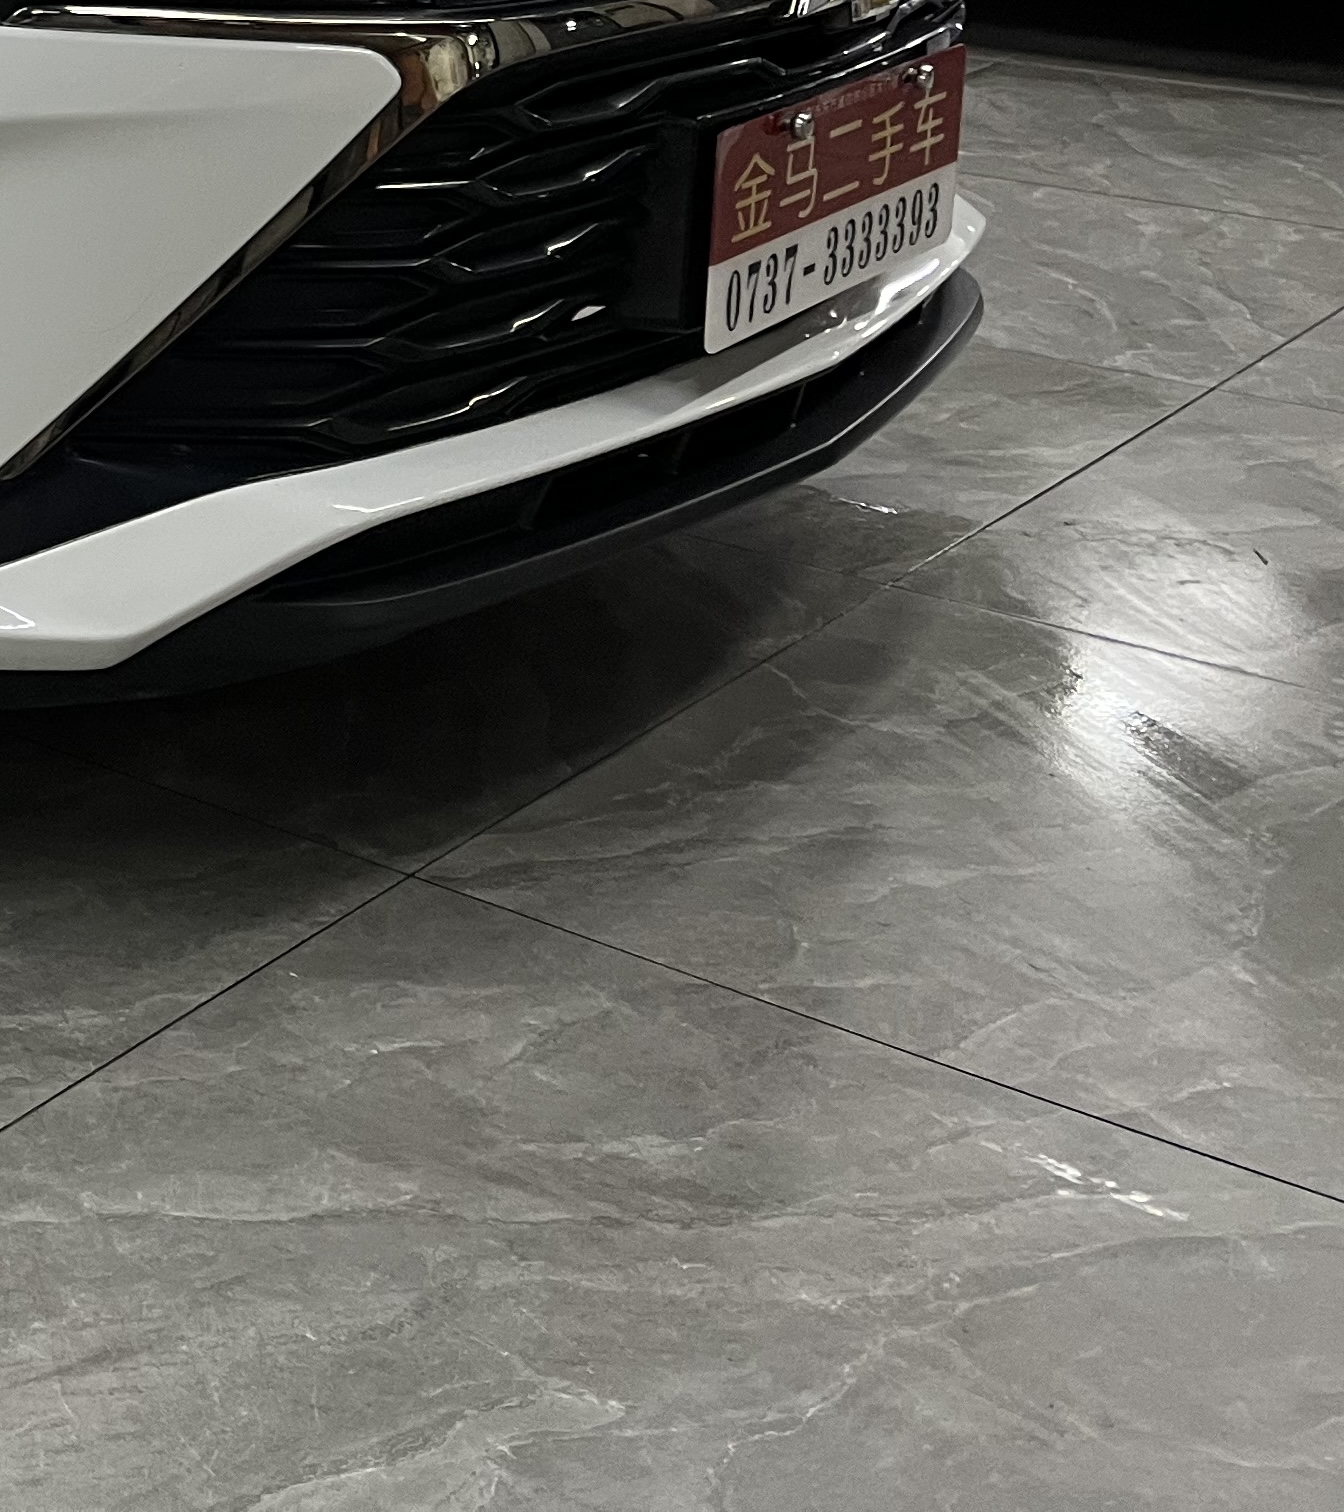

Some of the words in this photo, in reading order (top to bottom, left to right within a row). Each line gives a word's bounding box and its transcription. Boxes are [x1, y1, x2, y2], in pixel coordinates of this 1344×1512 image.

[731, 88, 947, 243] 金马二手车
[726, 182, 940, 332] 0737-3333393
